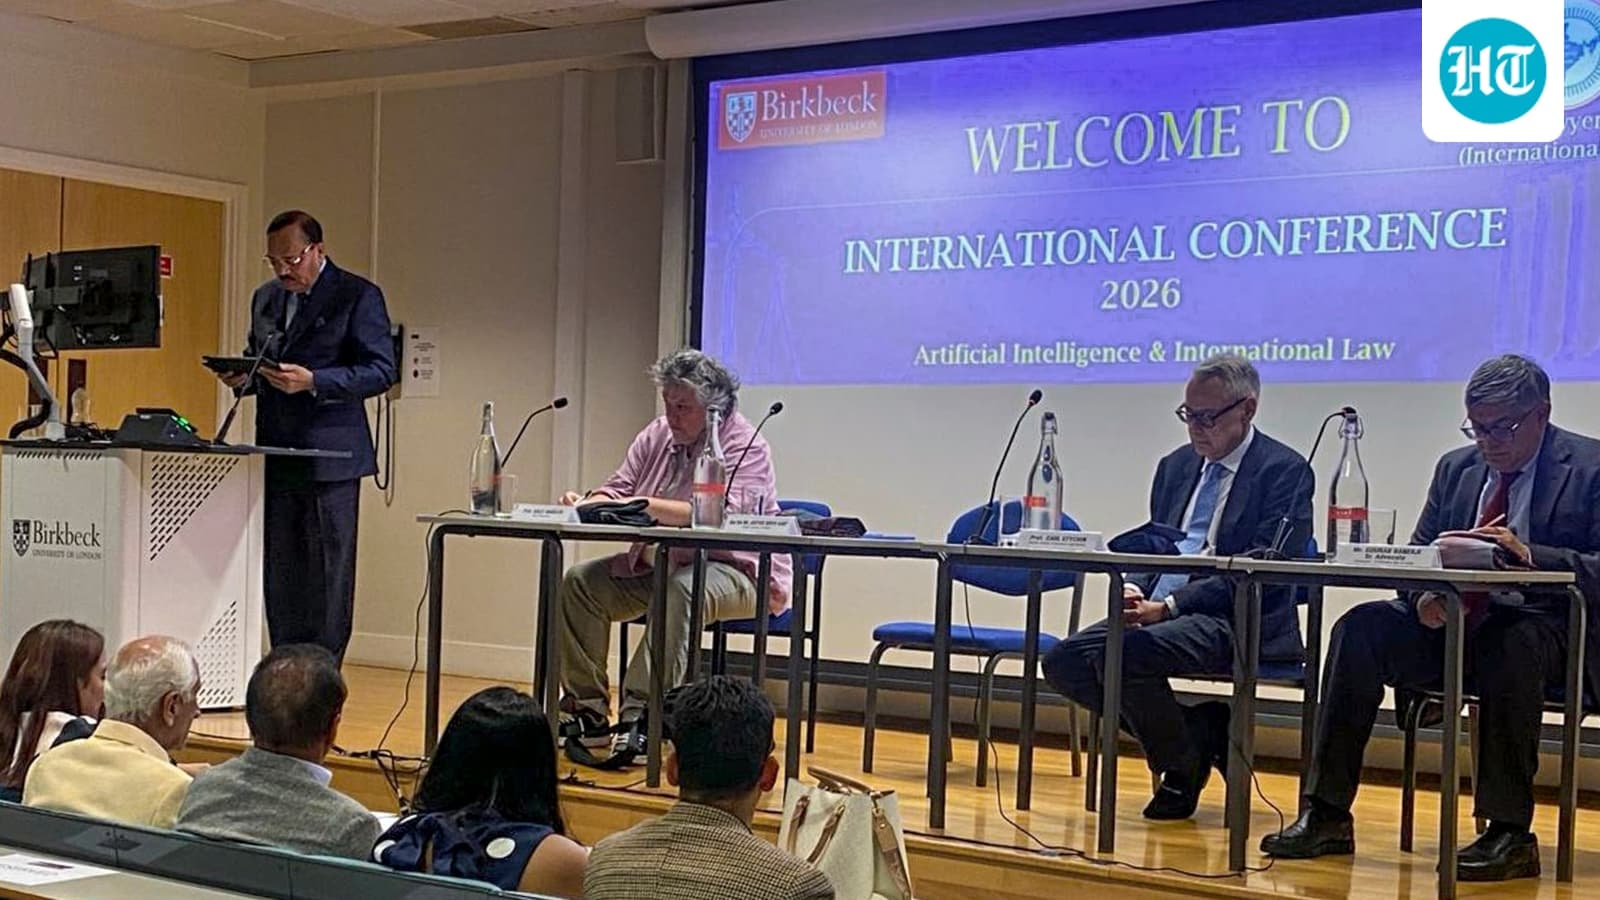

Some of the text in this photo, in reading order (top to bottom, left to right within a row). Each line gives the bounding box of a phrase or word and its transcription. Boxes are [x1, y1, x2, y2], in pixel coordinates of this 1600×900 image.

[761, 81, 877, 121] Birkbeck
[965, 96, 1351, 175] WELCOME TO
[1459, 143, 1600, 167] (Internationa
[843, 207, 1508, 274] INTERNATIONAL CONFERENCE
[1100, 277, 1182, 310] 2026
[913, 342, 1006, 366] Artificial
[1012, 340, 1142, 368] Intelligence
[1148, 340, 1167, 363] &
[1342, 337, 1396, 361] Law
[33, 520, 101, 547] Birkbeck
